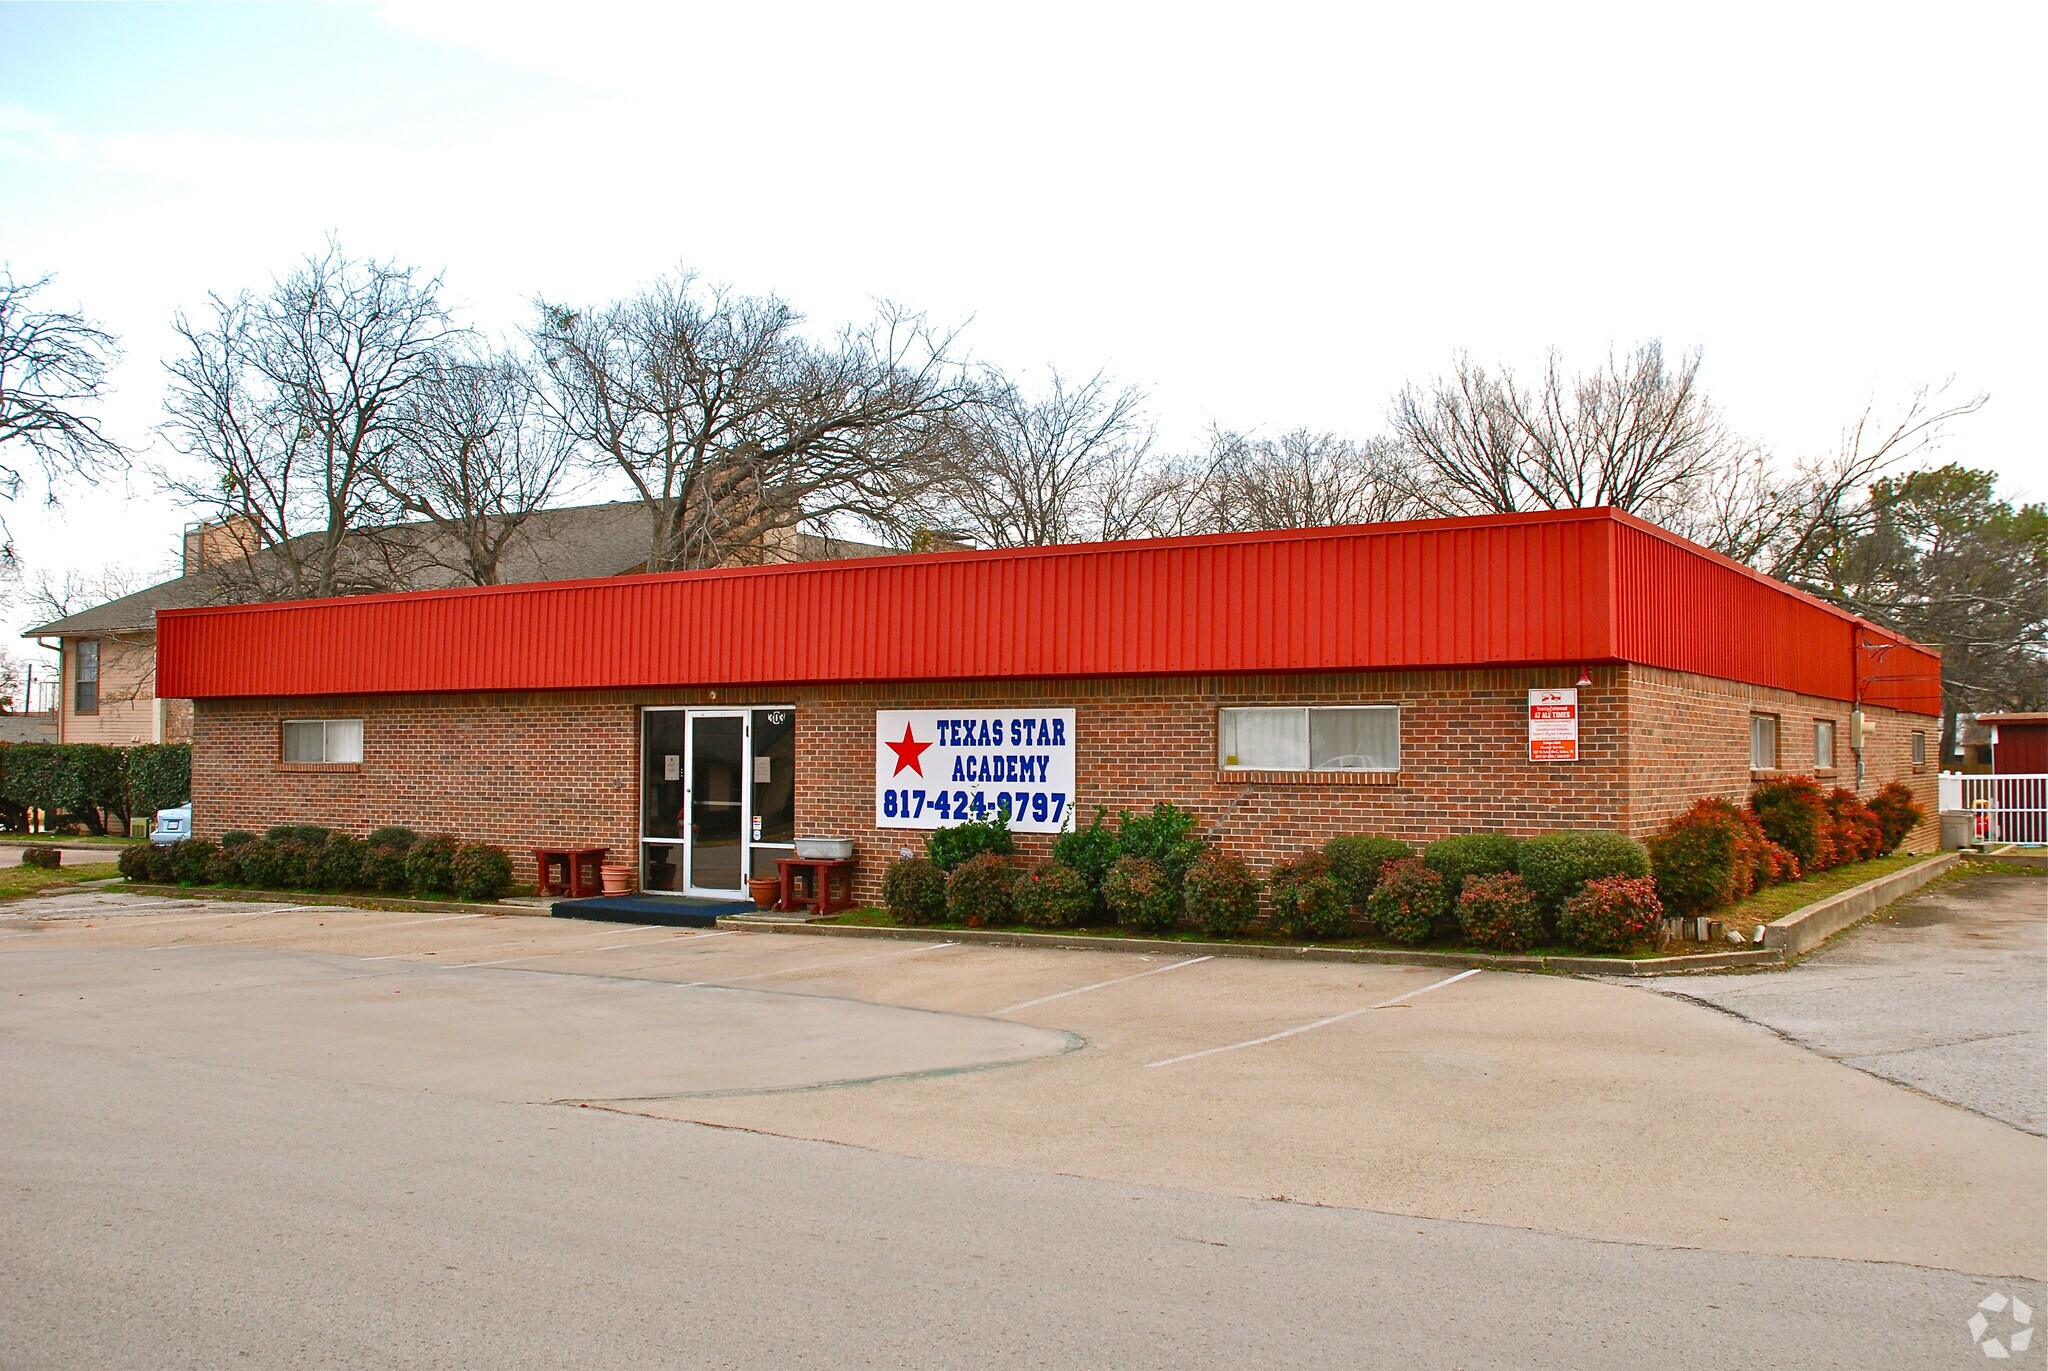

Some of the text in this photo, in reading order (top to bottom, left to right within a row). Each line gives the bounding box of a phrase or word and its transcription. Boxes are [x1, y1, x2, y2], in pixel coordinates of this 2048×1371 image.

[936, 718, 1066, 747] TEXAS STAR
[951, 755, 1050, 783] ACADEMY
[883, 789, 1066, 823] 817-424-9797
